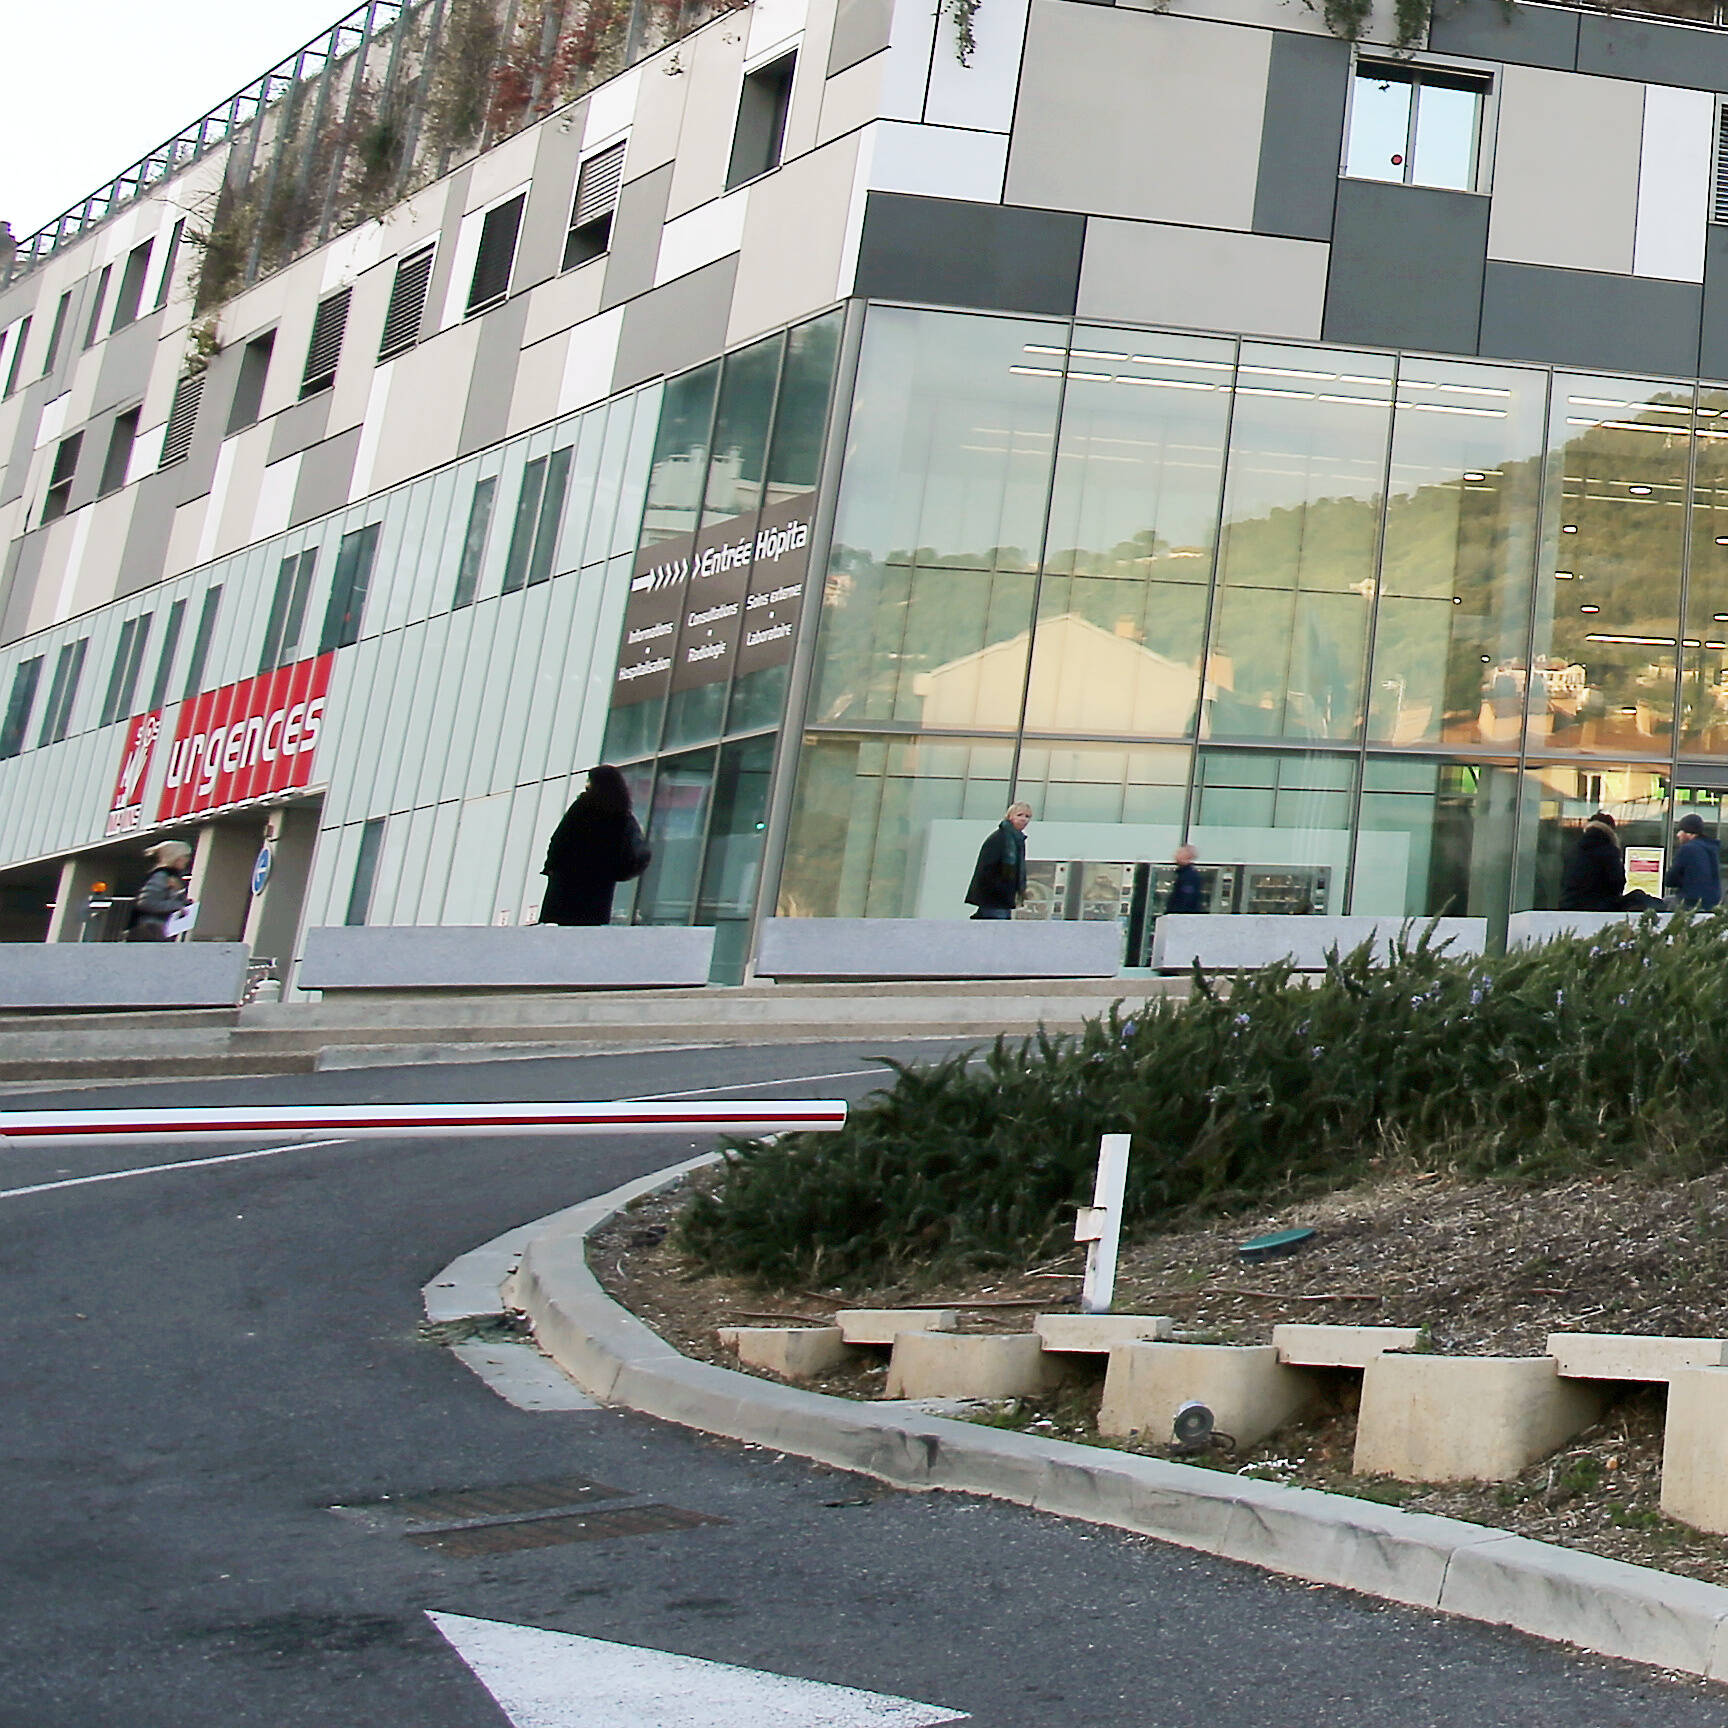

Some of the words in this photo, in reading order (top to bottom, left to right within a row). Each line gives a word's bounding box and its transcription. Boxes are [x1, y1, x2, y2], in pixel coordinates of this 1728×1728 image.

[701, 538, 753, 577] Entrée
[754, 517, 813, 562] Hôpita
[166, 696, 326, 796] urgences
